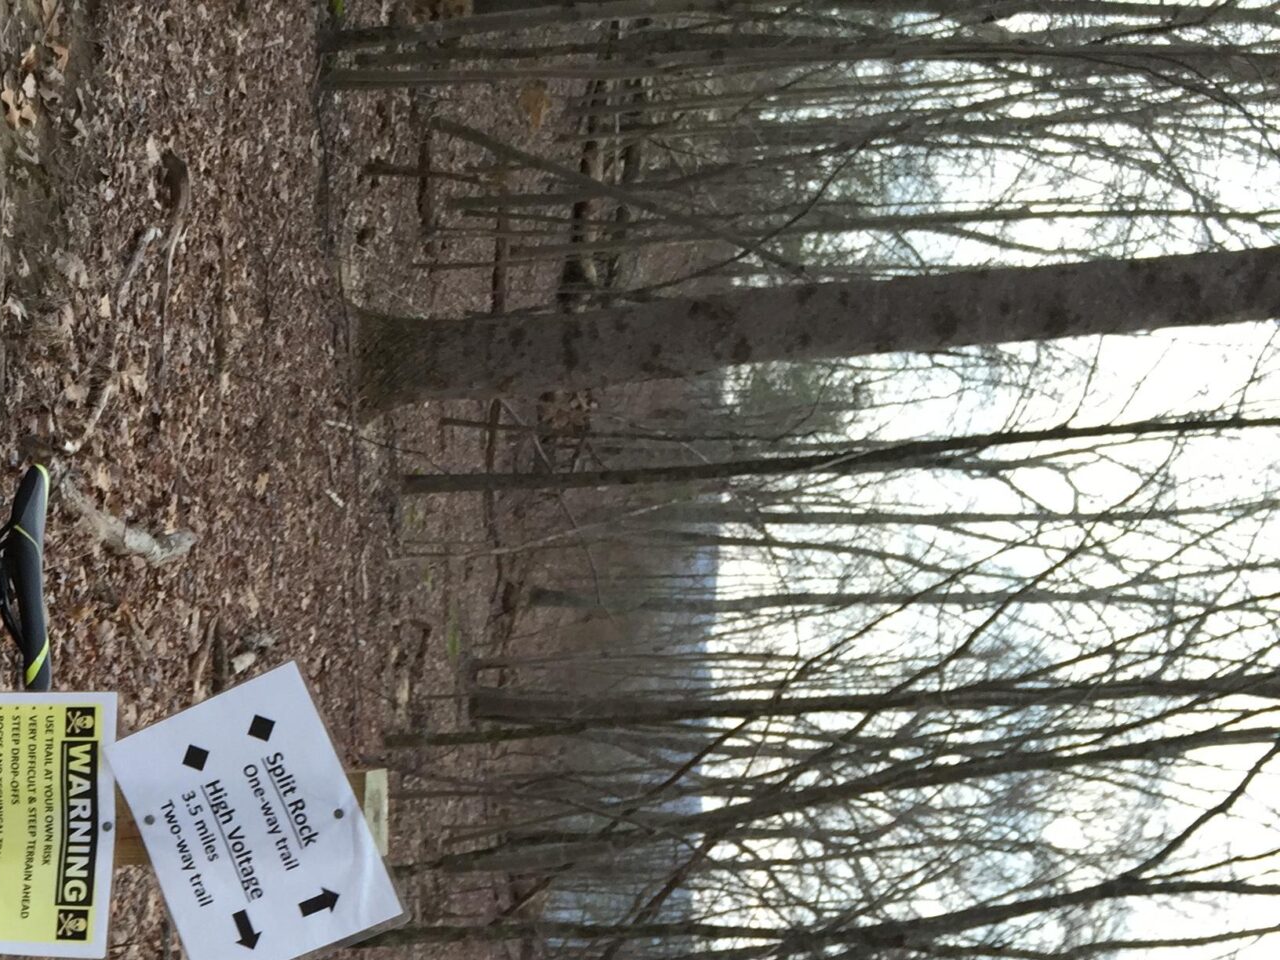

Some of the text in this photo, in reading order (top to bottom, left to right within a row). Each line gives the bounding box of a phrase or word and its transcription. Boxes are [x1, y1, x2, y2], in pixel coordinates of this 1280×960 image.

[10, 716, 20, 805] STEEP DROP-OFFS
[42, 716, 54, 865] USE TRAIL AT YOUR OWN RISK
[265, 752, 319, 847] Split Rock
[20, 715, 37, 919] VERY DIFFICULT & STEEP TERRAIN AHEAD
[63, 743, 91, 902] WARNING
[160, 800, 213, 908] Two-way trail
[182, 790, 220, 862] 3.5 miles
[205, 779, 265, 901] High Voltage
[243, 764, 298, 871] One-way trail
